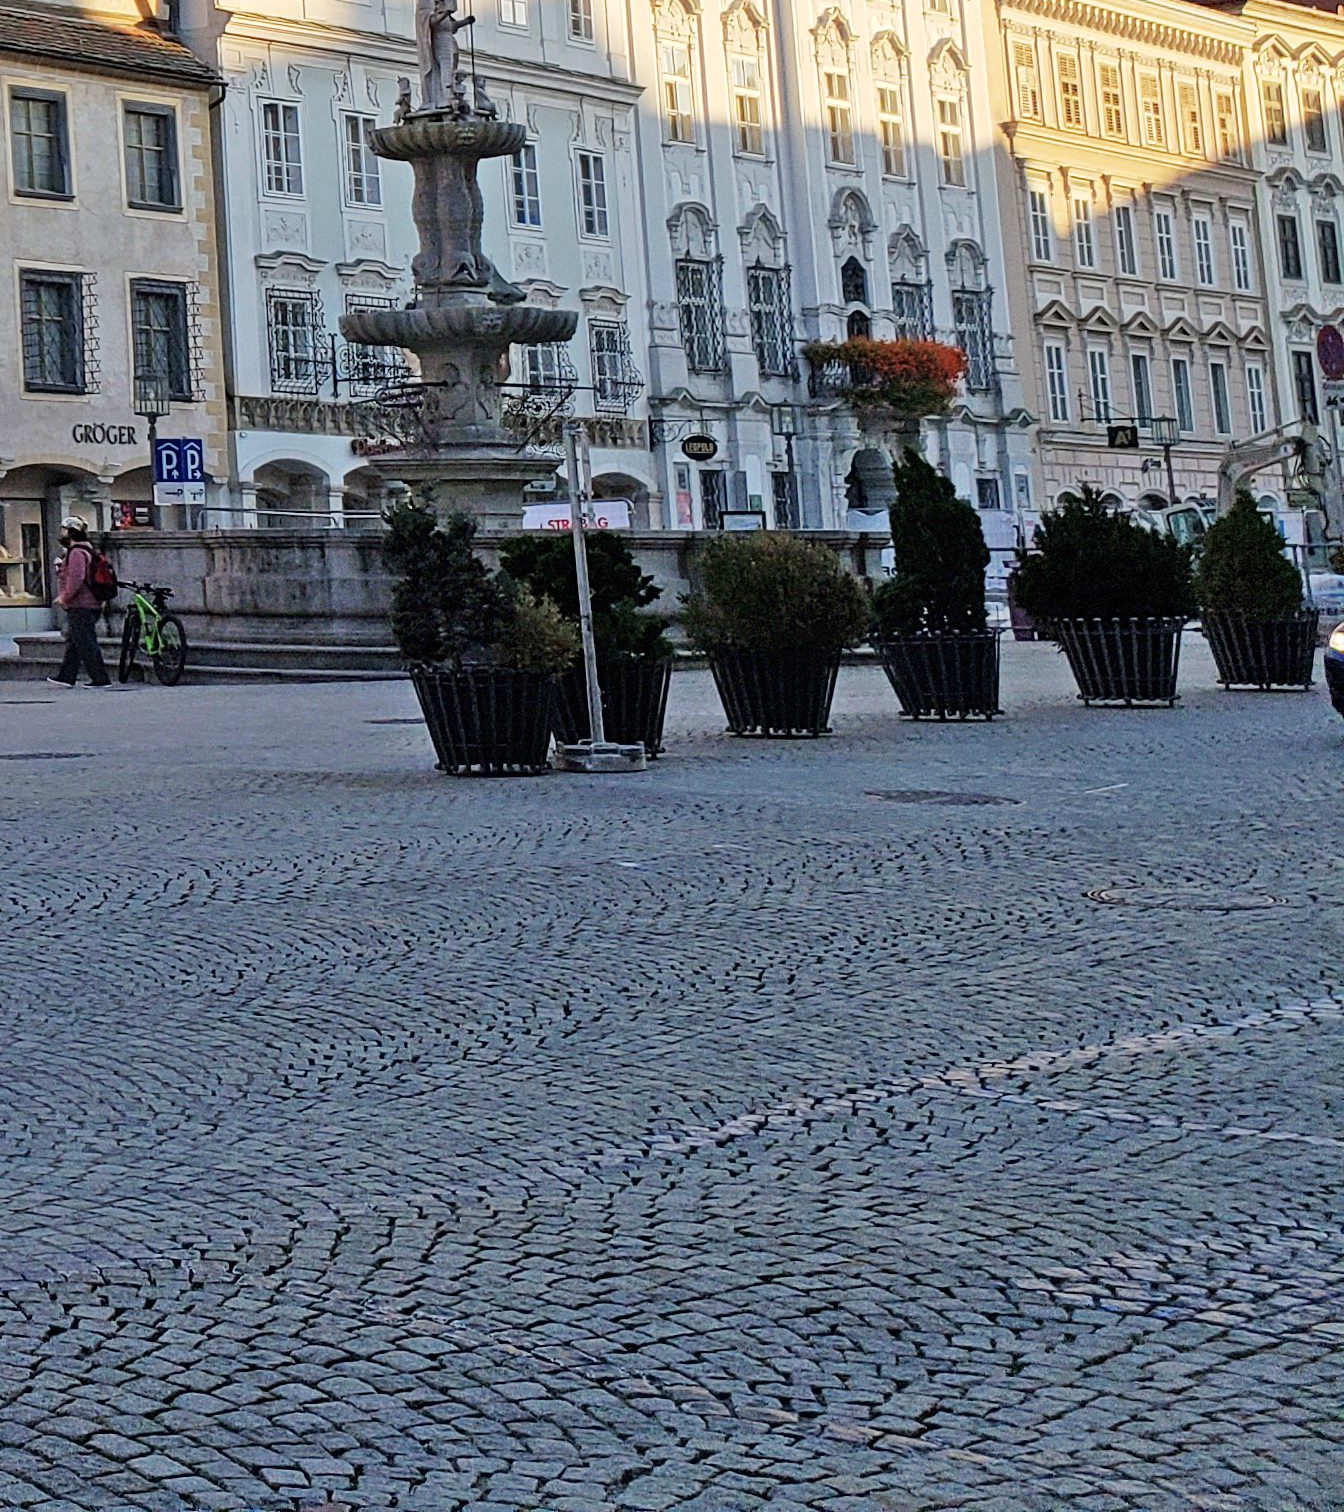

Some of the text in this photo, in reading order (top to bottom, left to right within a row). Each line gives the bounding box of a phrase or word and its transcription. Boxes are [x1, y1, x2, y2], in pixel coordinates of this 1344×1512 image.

[72, 422, 138, 445] GRÖGER
[161, 449, 200, 480] P P
